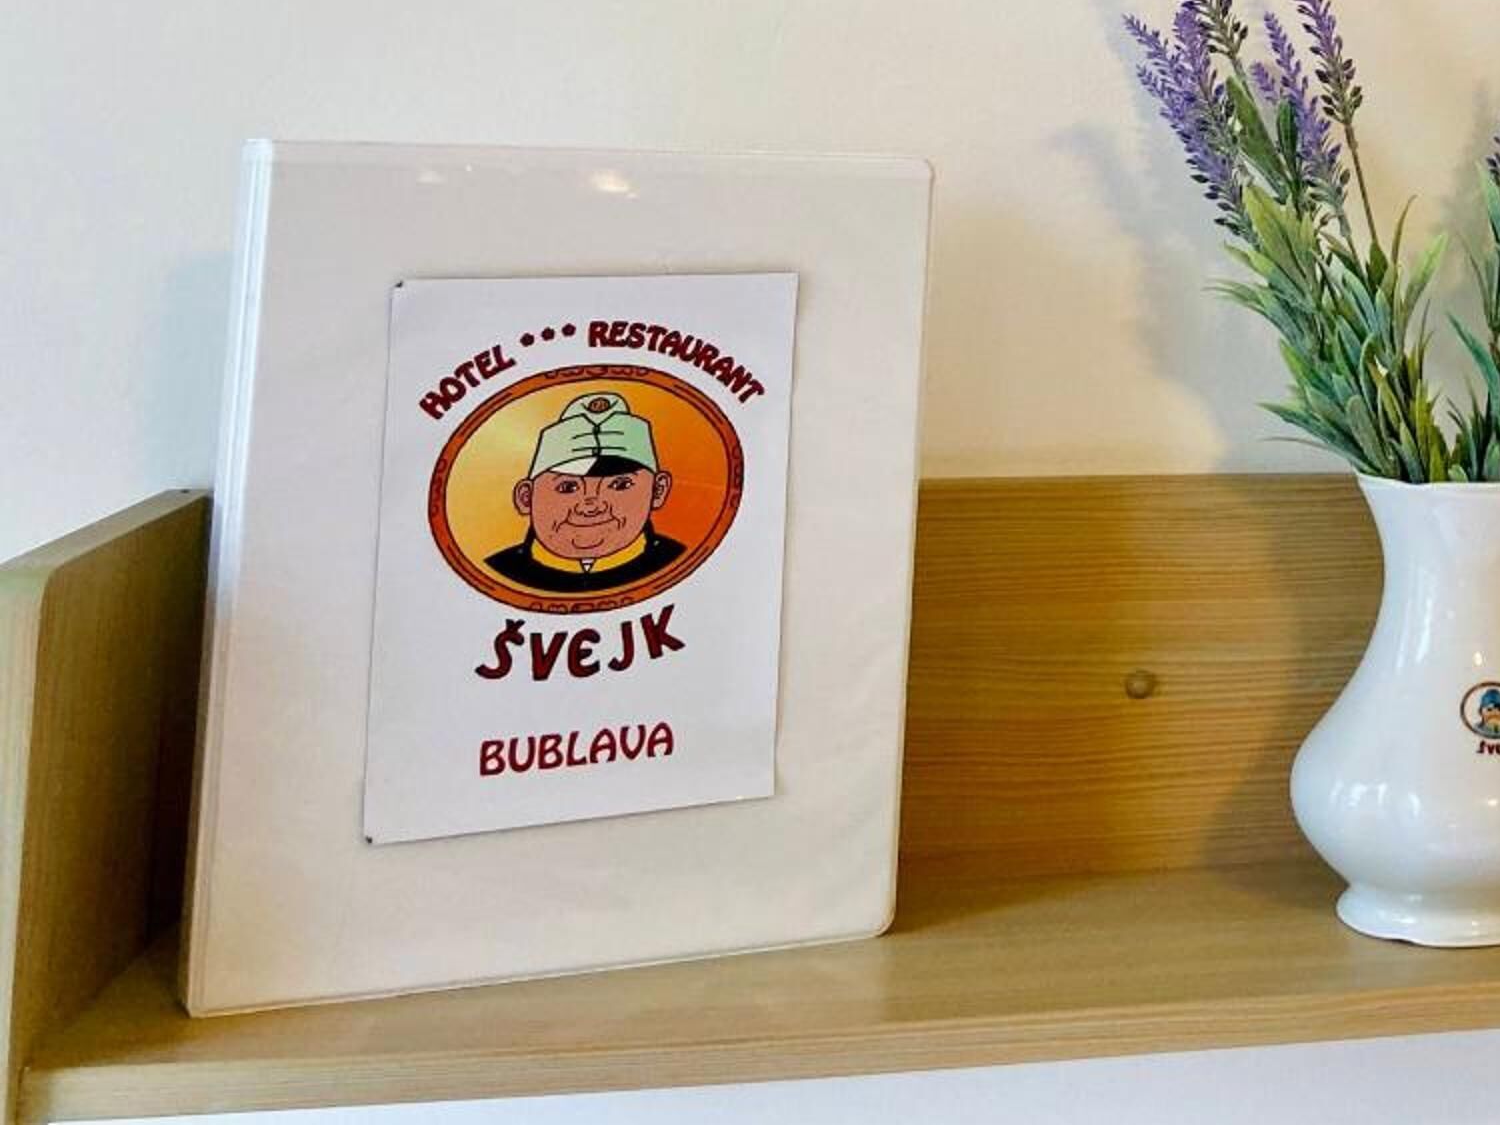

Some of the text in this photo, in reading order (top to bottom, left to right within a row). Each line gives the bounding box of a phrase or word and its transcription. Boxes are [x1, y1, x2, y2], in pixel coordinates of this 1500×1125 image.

[418, 320, 766, 421] HOTEL RESTAURANT
[474, 603, 686, 682] ŠVEJK
[479, 721, 674, 777] BUBLAVA
